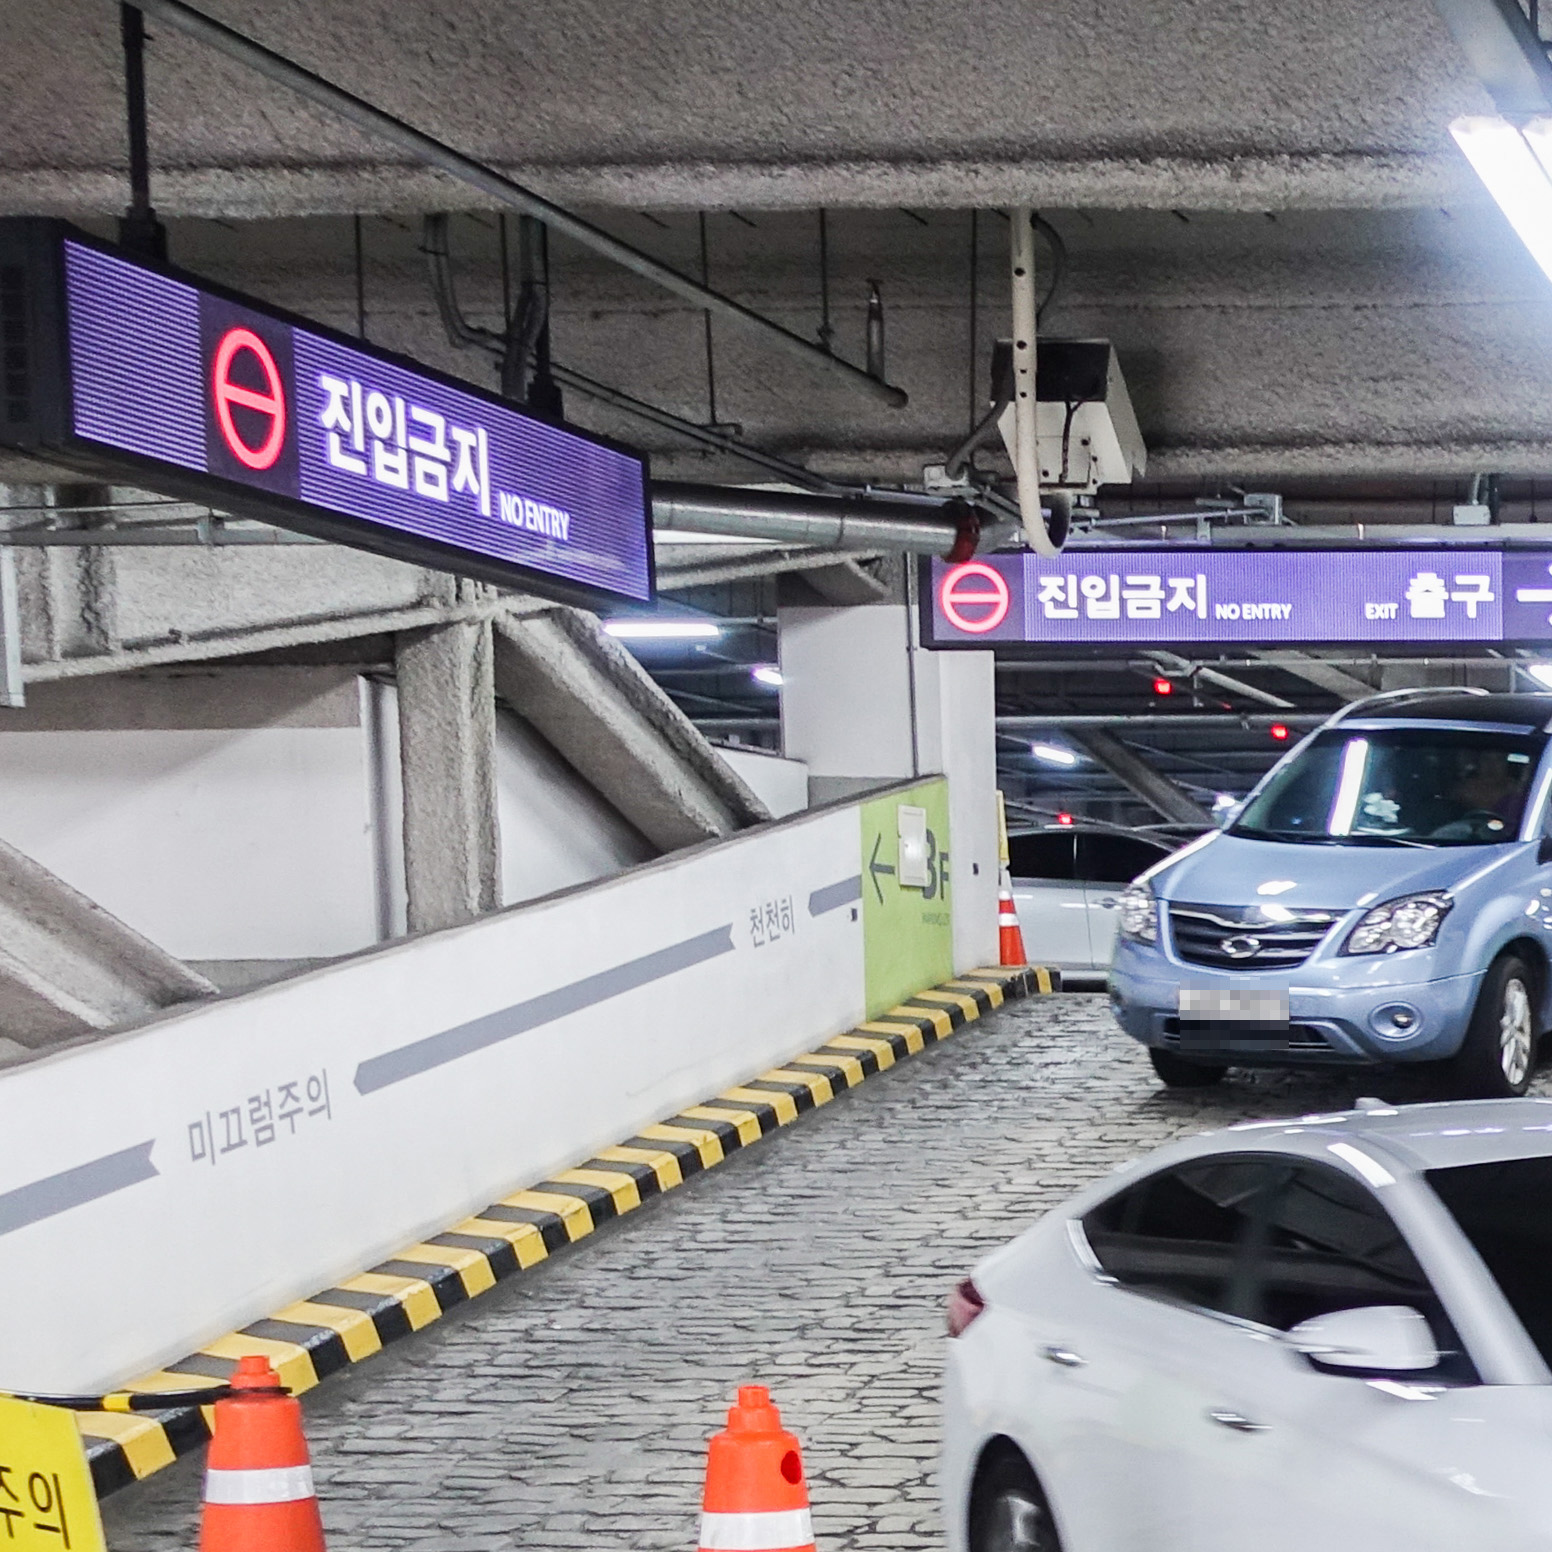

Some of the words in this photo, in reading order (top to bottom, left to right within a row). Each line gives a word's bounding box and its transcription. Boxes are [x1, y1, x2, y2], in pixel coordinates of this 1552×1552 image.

[320, 374, 492, 517] 진입금지
[500, 492, 524, 527] NO
[526, 504, 570, 541] ENTRY
[1038, 574, 1207, 620] 진입금지
[1215, 603, 1241, 620] NO
[1242, 603, 1293, 620] ENTRY
[1365, 602, 1399, 620] EXIT
[1405, 572, 1495, 619] 출구
[750, 893, 795, 949] 천천히
[188, 1067, 331, 1166] 미끄럼주의
